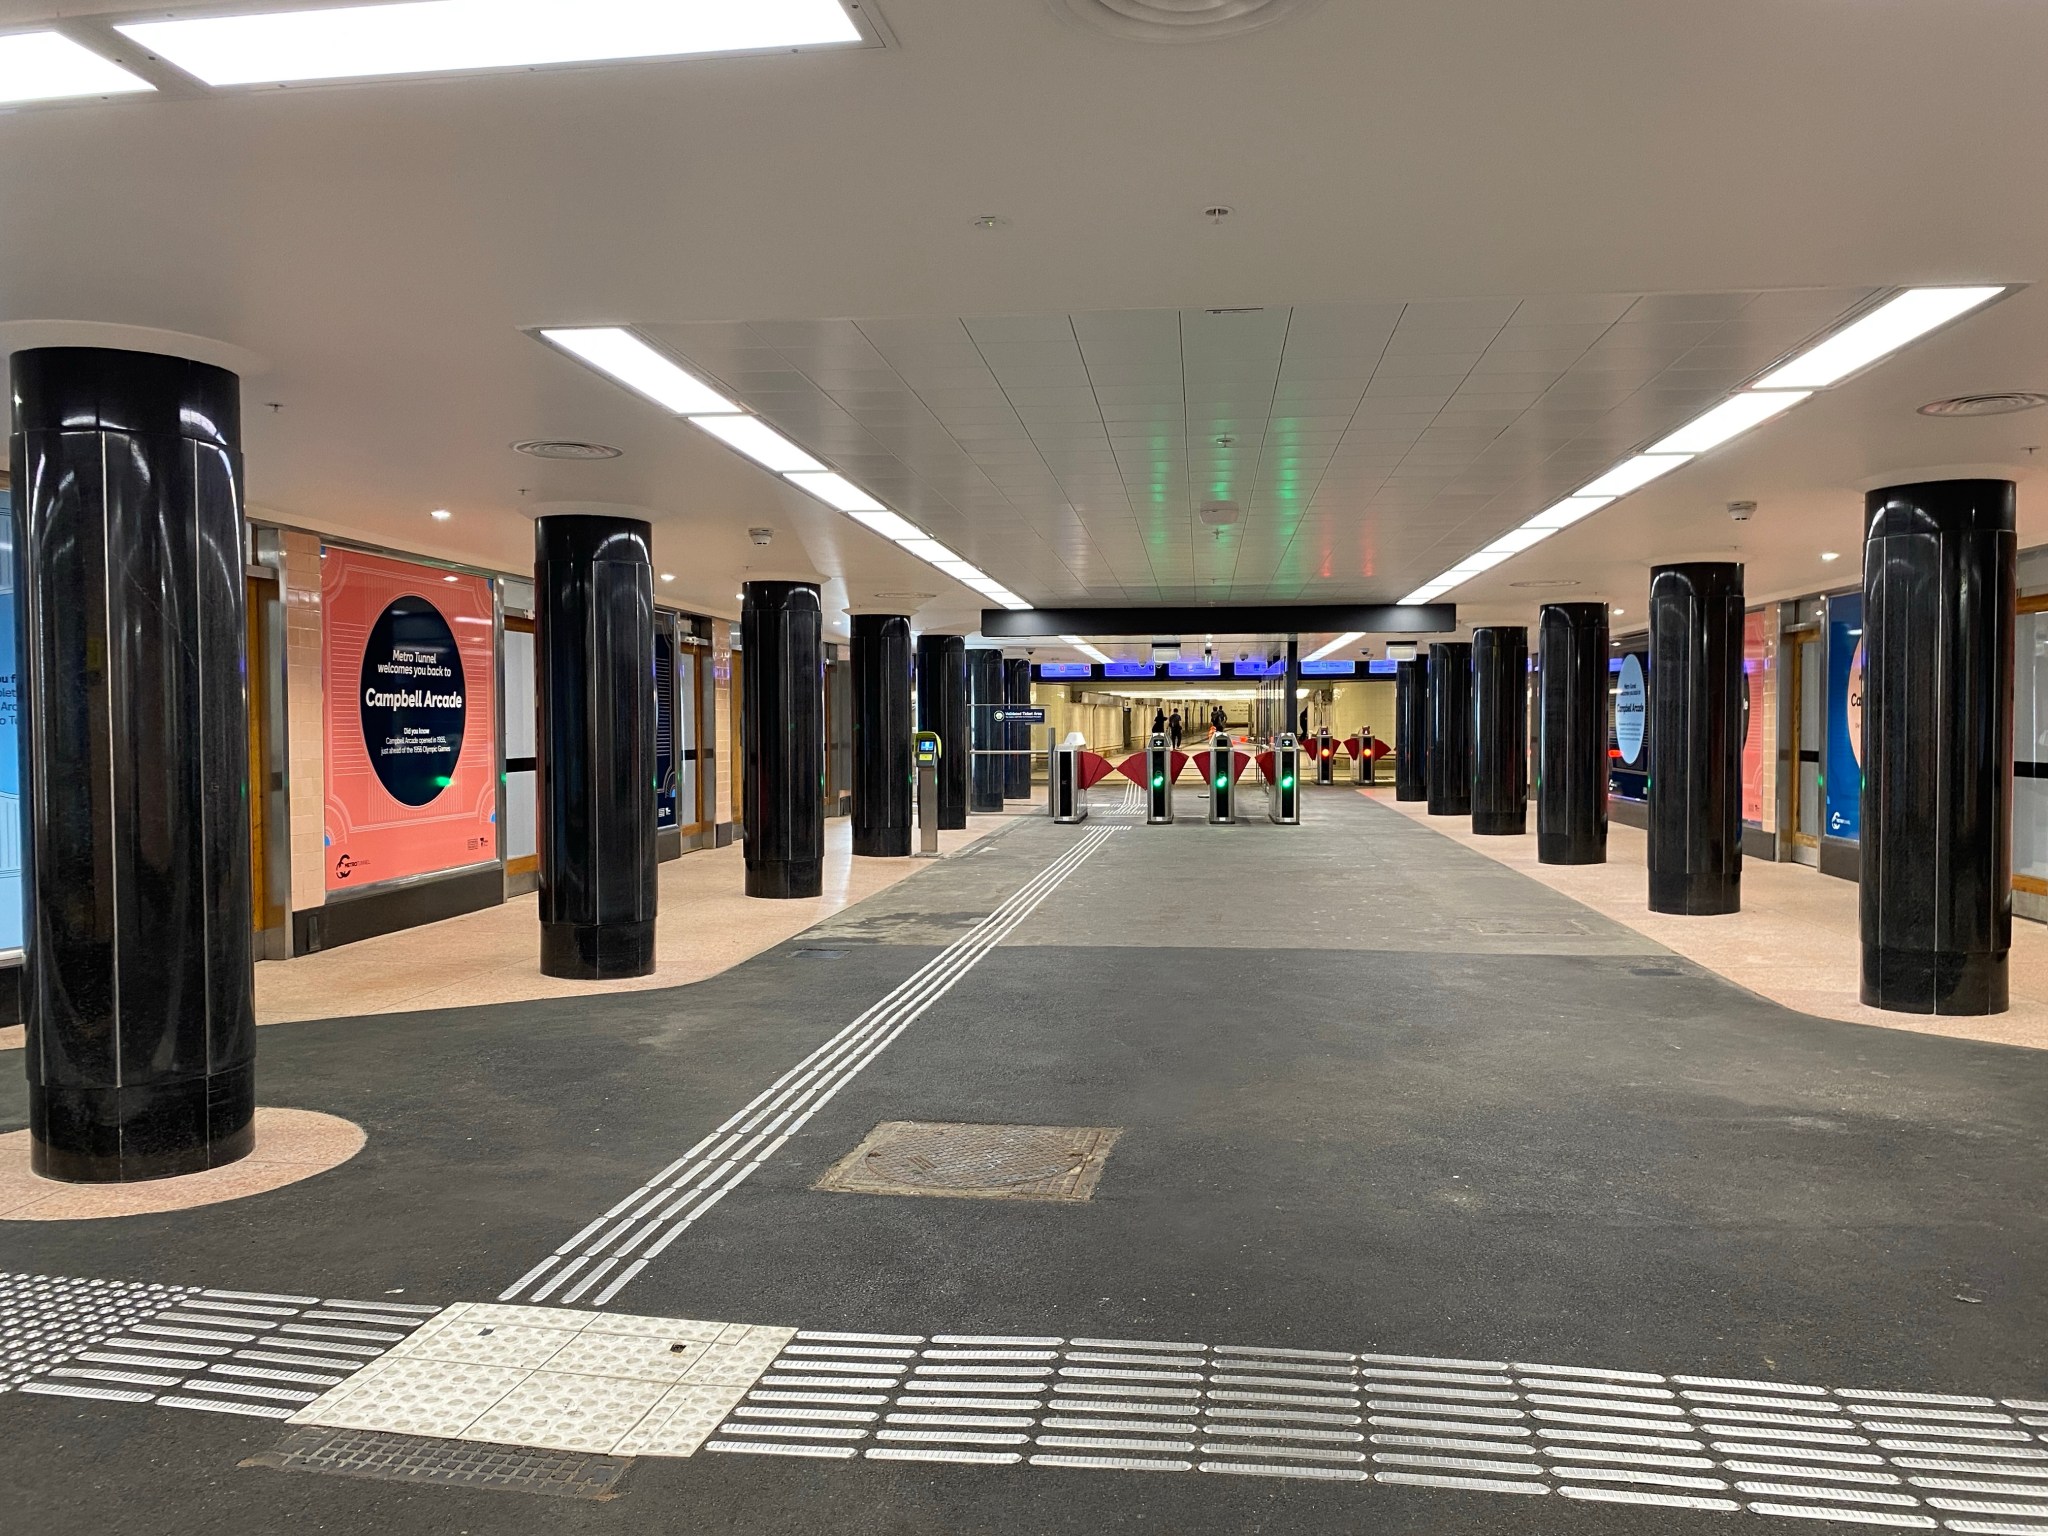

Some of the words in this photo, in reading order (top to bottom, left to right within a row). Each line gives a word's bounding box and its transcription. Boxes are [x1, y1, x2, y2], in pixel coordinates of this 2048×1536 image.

[392, 649, 414, 662] Metro
[414, 651, 437, 664] Tunnel
[377, 662, 413, 675] welcomes
[413, 666, 426, 678] you
[426, 664, 444, 677] back
[444, 666, 452, 677] to
[365, 687, 422, 712] Campbell
[423, 690, 463, 708] Arcade
[385, 737, 404, 745] Campbell
[419, 736, 433, 745] opened
[380, 746, 389, 756] just
[389, 746, 402, 754] ahead
[422, 745, 437, 754] Olympic
